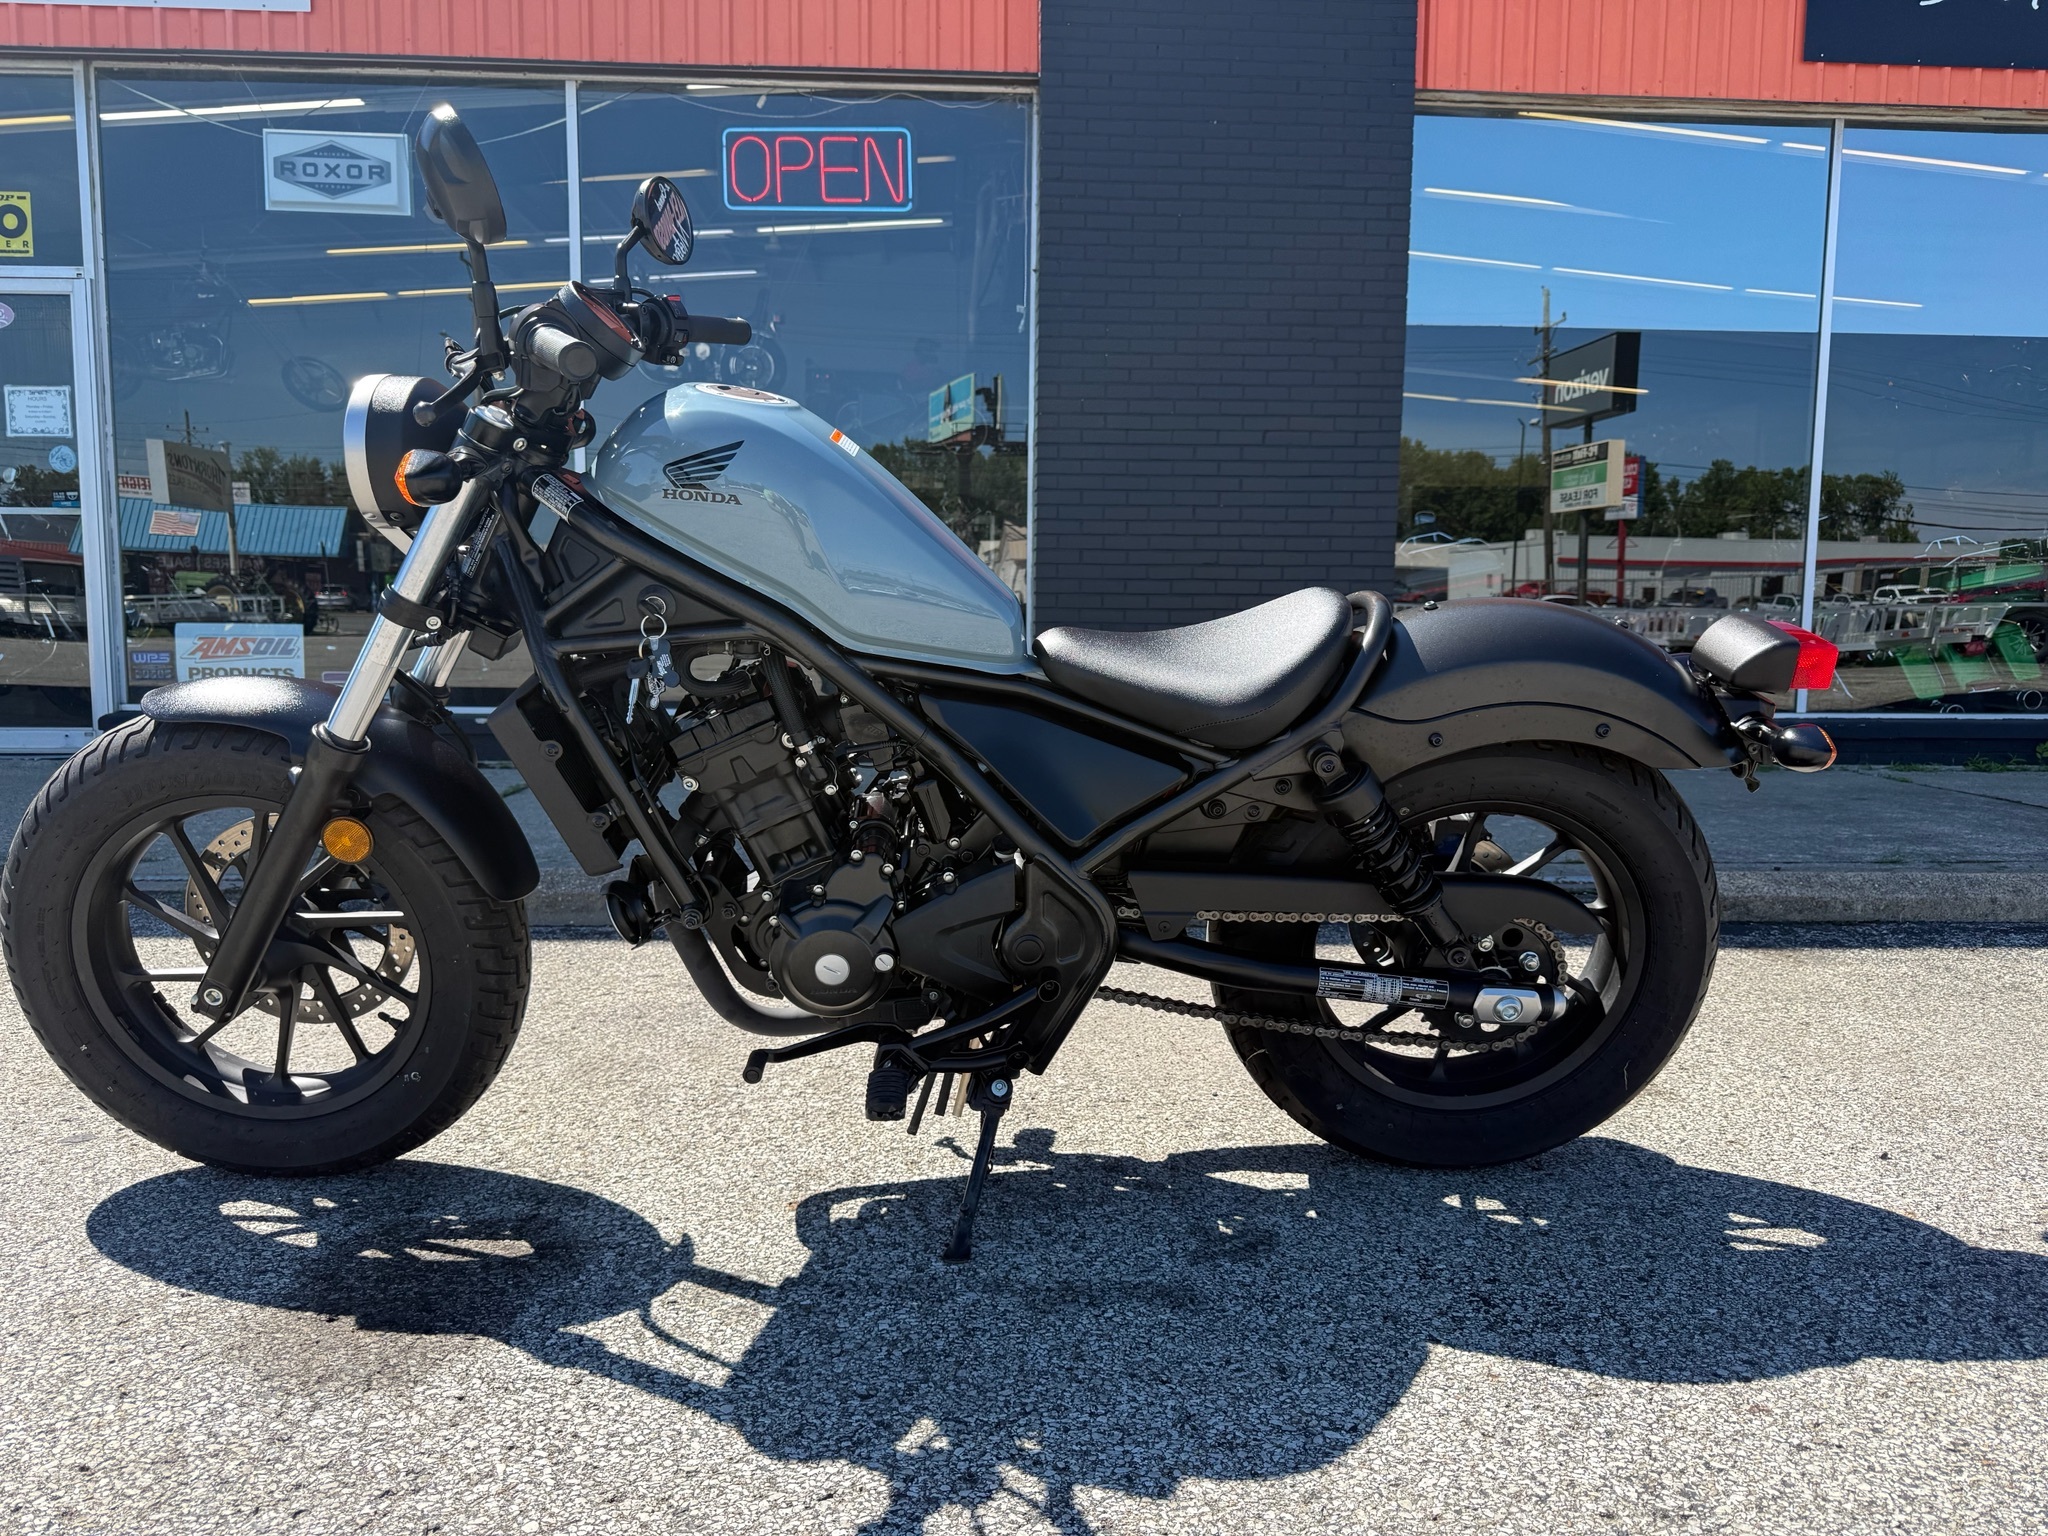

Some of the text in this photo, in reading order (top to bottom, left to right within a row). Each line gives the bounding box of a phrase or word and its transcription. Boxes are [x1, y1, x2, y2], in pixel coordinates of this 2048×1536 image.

[279, 160, 386, 181] ROXOR
[730, 136, 904, 203] OPEN
[662, 488, 743, 505] HONDA
[133, 652, 170, 664] WPS
[187, 637, 298, 660] AMSOIL
[188, 667, 295, 681] PRODUCTS
